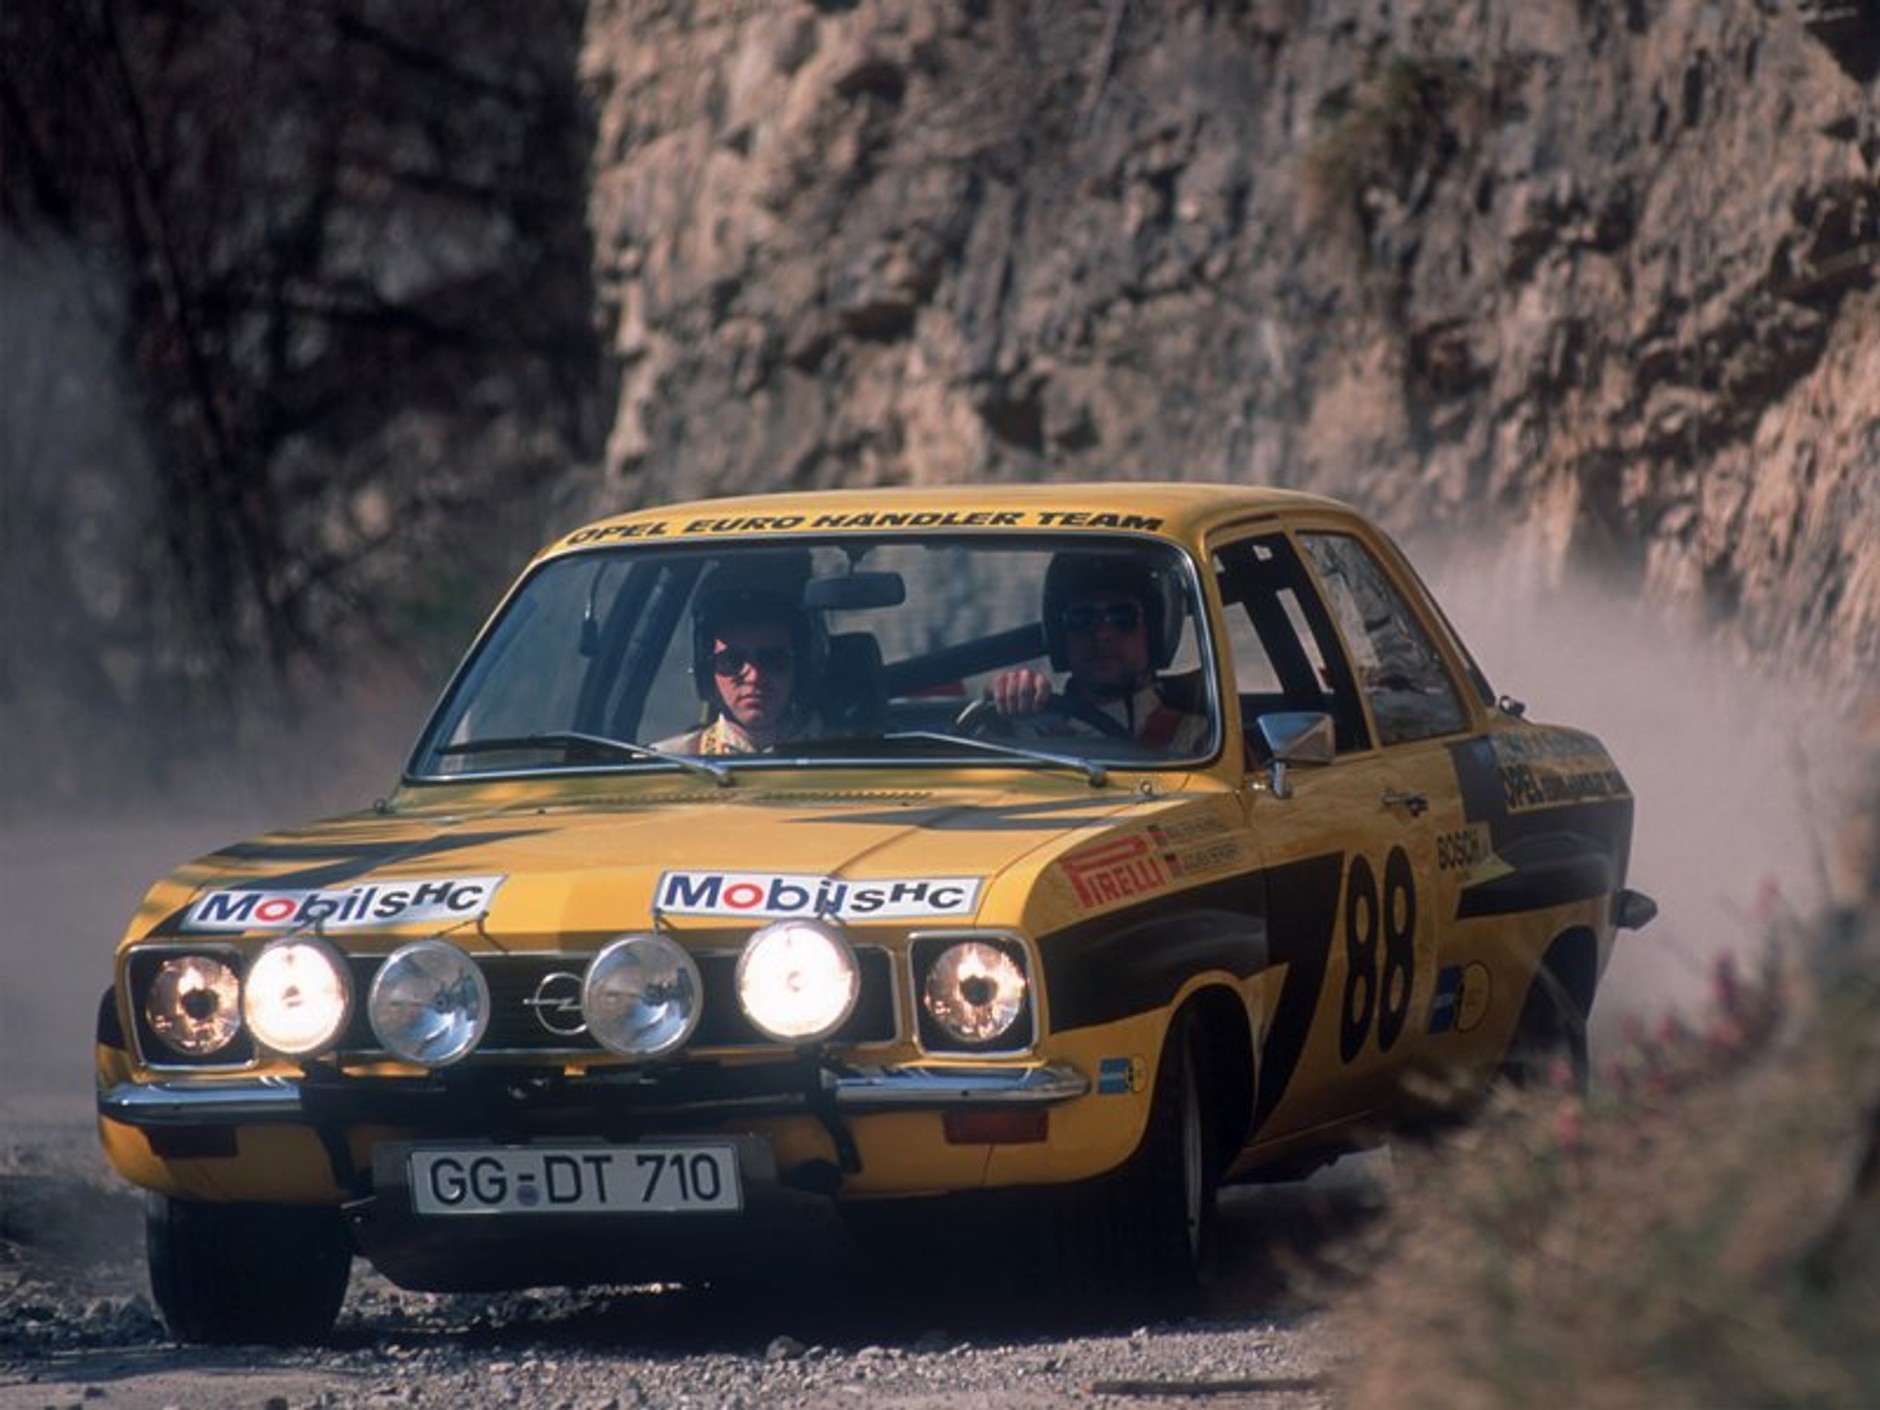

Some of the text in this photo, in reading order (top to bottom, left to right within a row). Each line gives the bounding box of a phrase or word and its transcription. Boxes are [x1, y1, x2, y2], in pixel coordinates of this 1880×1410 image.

[566, 521, 668, 545] OPEL
[682, 515, 807, 534] EURO
[1036, 512, 1167, 531] TEAM
[1058, 834, 1166, 909] PIRELLI
[1339, 844, 1416, 1064] 88
[636, 1153, 722, 1203] 710
